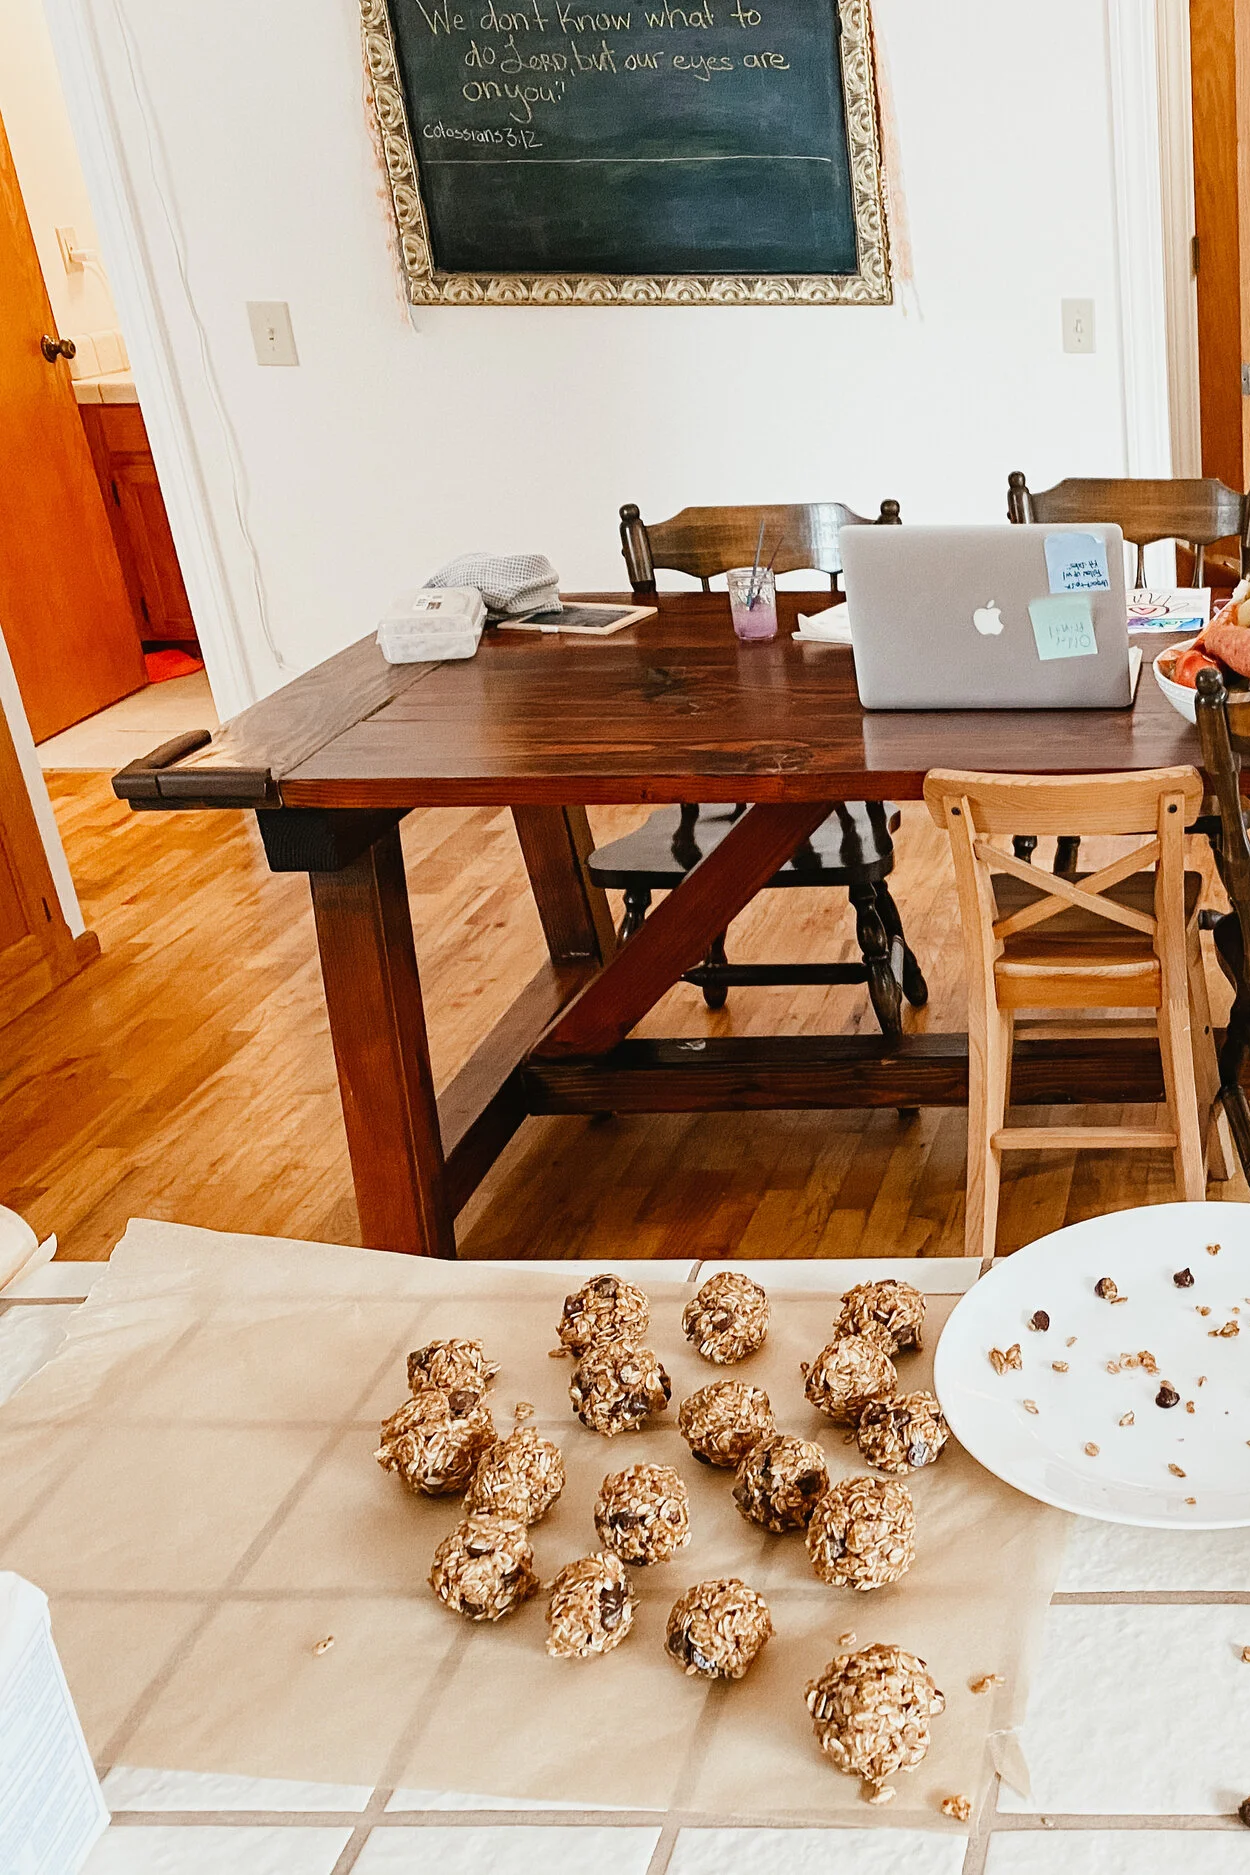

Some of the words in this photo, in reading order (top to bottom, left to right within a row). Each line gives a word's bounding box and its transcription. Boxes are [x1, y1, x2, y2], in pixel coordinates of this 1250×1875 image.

[416, 0, 466, 35] We
[645, 0, 713, 29] what
[730, 0, 761, 28] to
[465, 40, 496, 68] do
[571, 41, 617, 73] but
[625, 52, 664, 70] our
[673, 53, 733, 82] eyes
[743, 52, 790, 70] are
[462, 81, 501, 102] on
